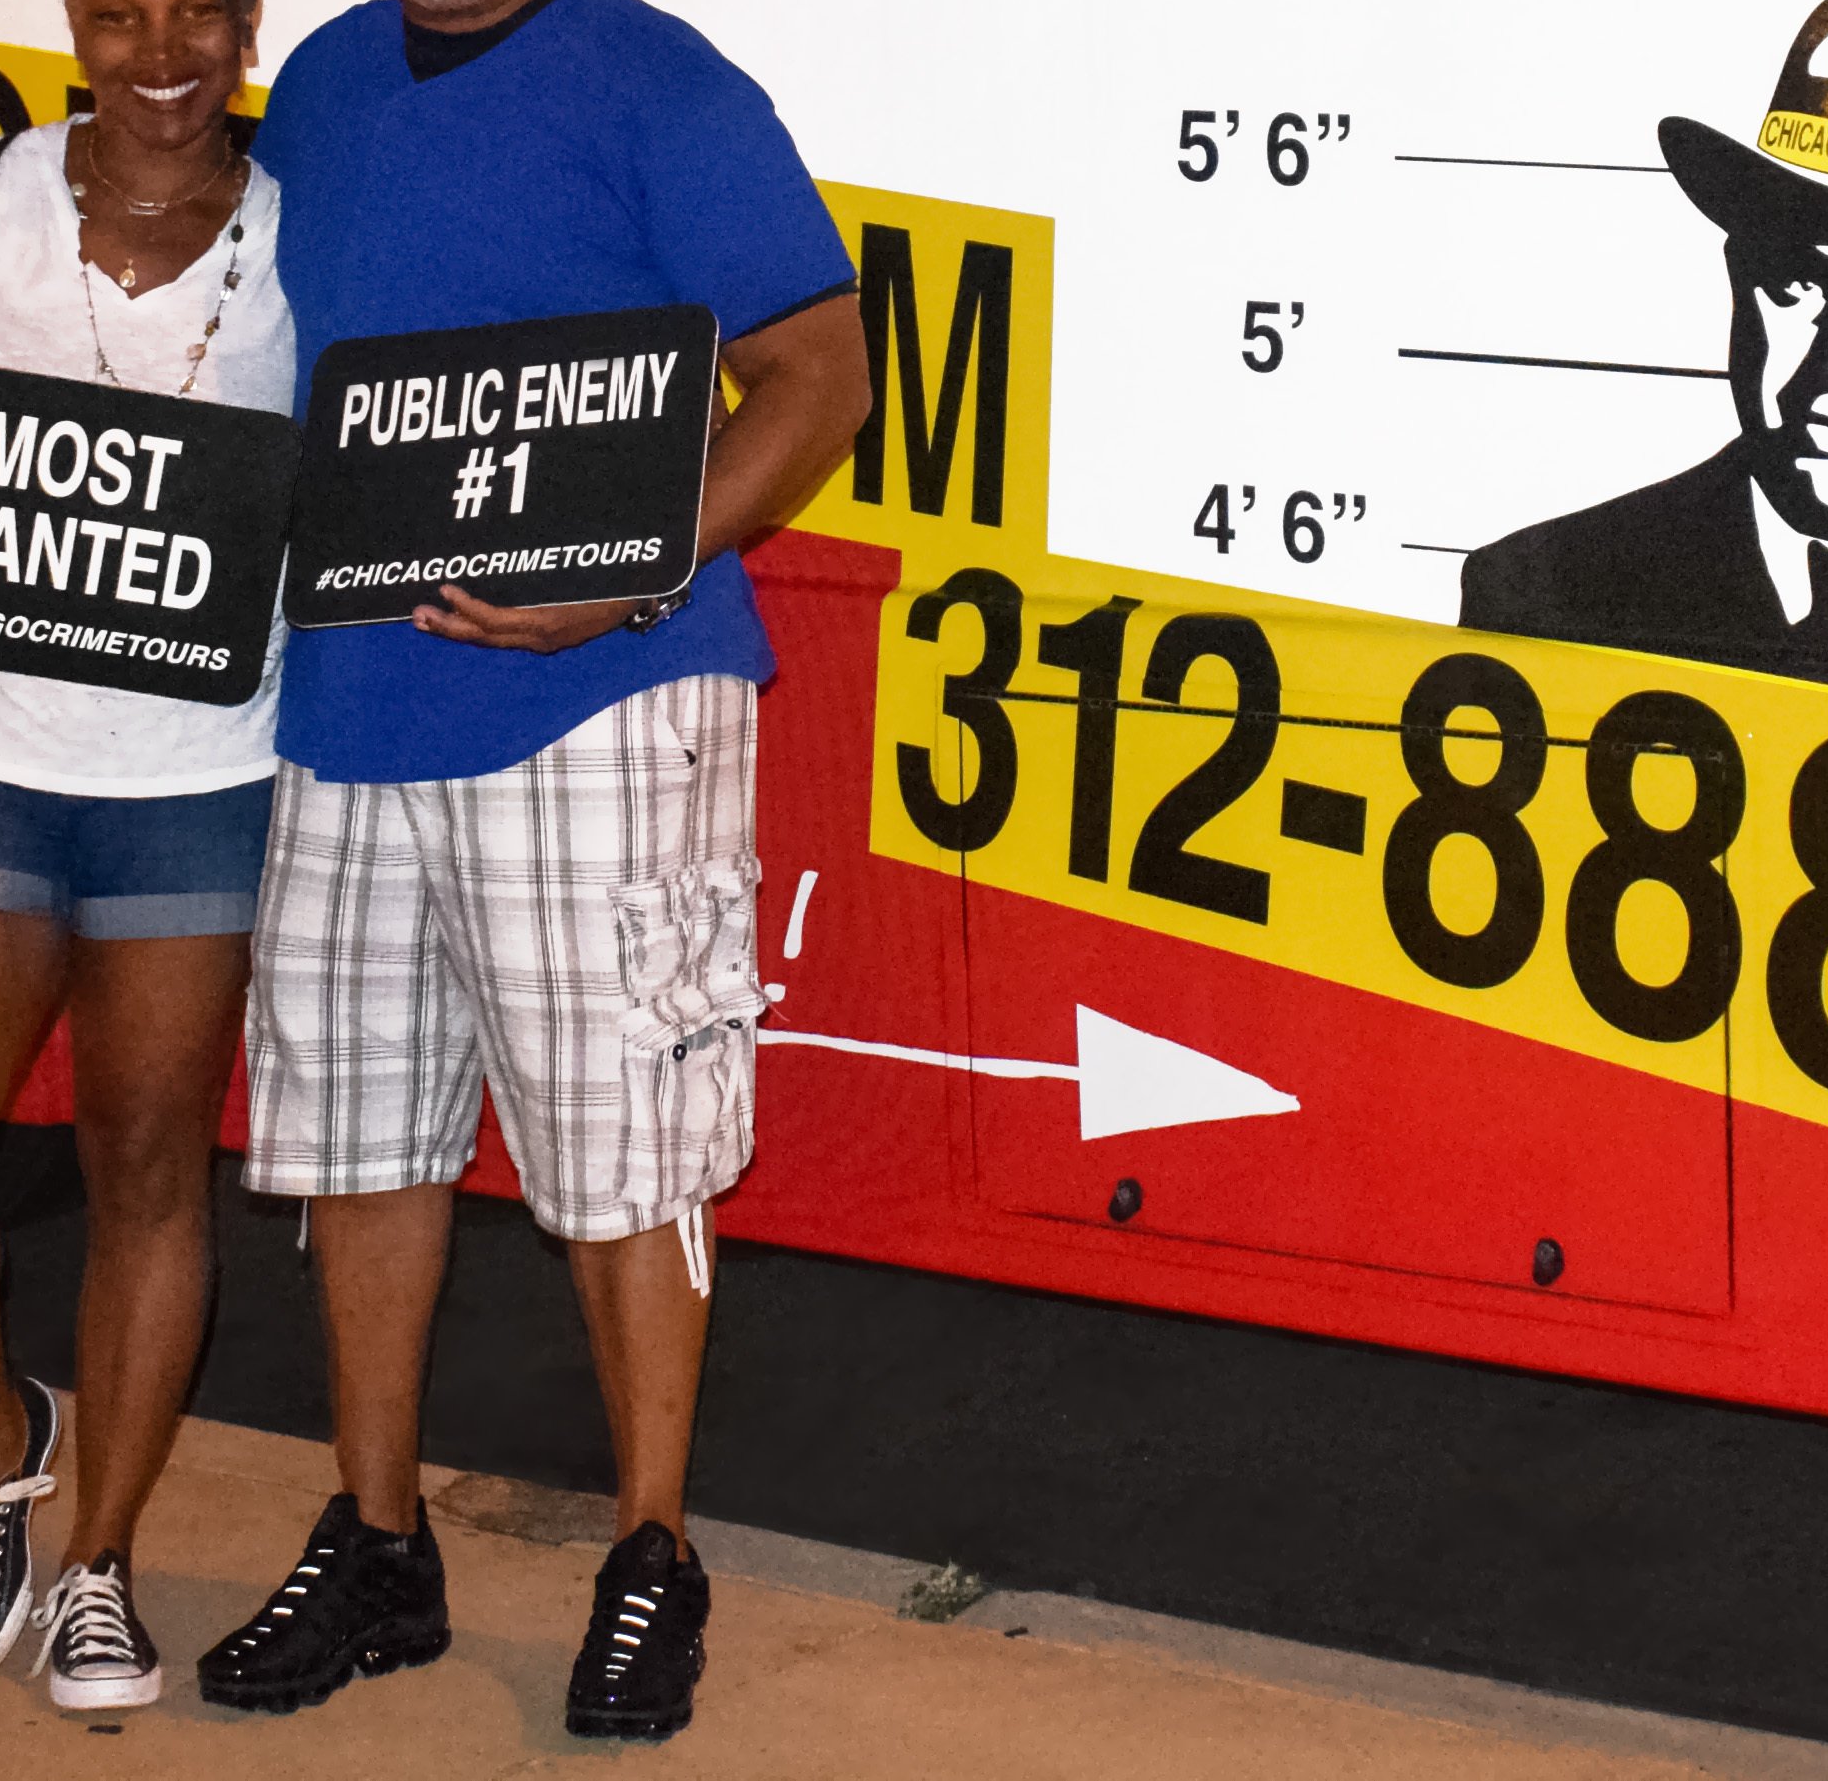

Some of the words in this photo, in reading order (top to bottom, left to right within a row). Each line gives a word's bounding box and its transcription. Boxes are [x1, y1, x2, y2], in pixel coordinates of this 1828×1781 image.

[1177, 109, 1240, 183] 5'
[1241, 300, 1305, 374] 5'
[339, 368, 507, 449] PUBLIC
[514, 351, 679, 430] ENEMY
[452, 441, 531, 519] #1
[1193, 483, 1257, 554] 4'
[315, 537, 663, 591] #CHICAGOCRIMETOURS
